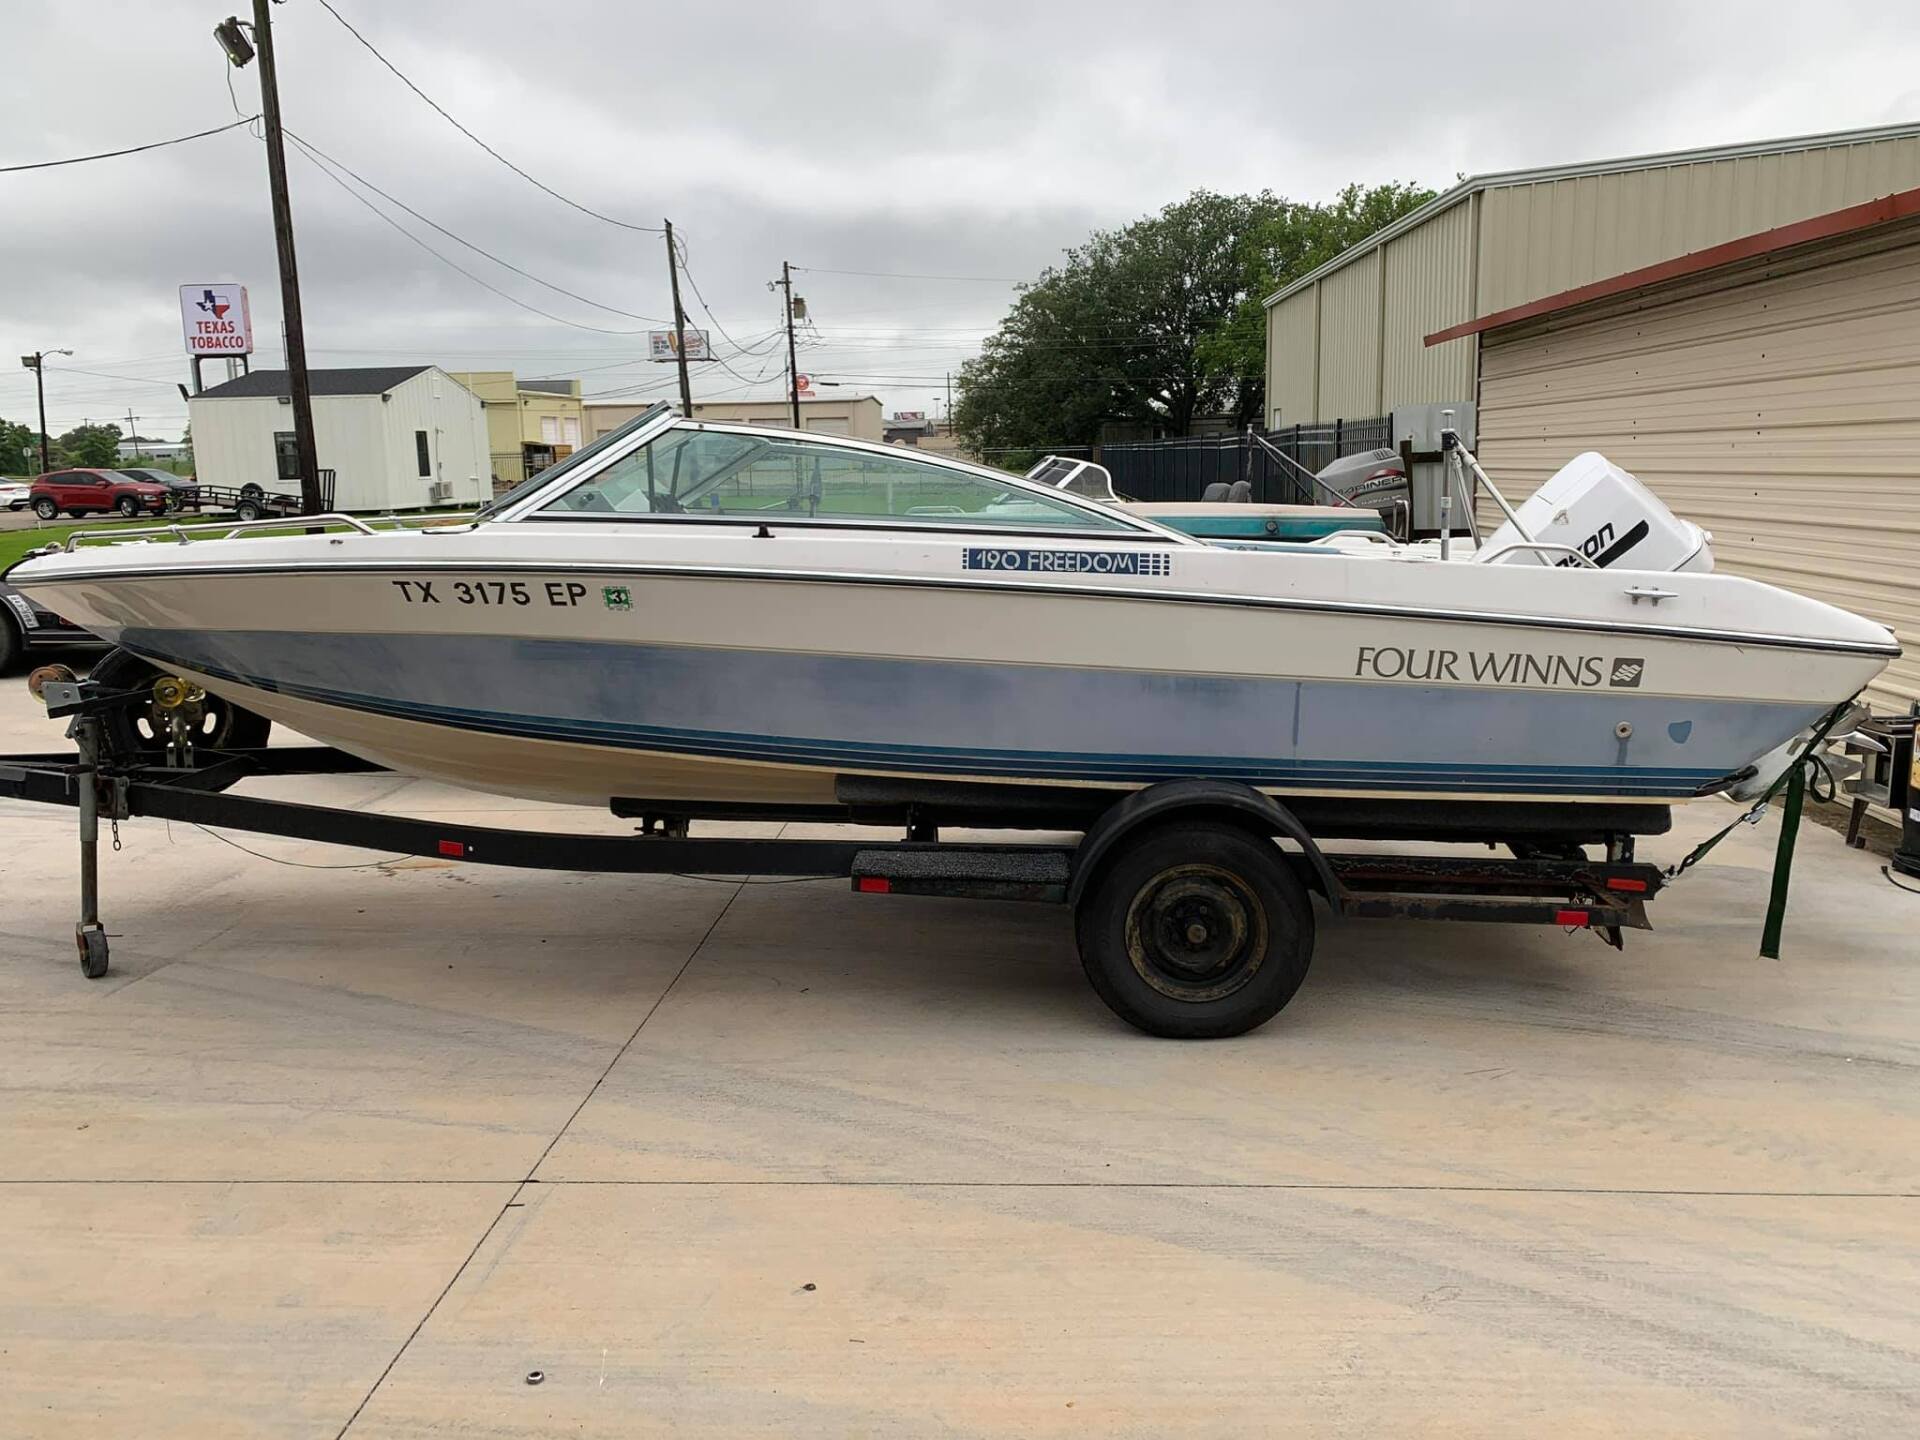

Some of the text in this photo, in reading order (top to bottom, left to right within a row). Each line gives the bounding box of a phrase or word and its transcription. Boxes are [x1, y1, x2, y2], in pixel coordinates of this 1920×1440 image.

[196, 321, 235, 334] TEXAS
[190, 336, 244, 349] TOBACCO
[976, 550, 1134, 573] 190 FREEDOM
[392, 580, 440, 603] TX
[453, 581, 531, 605] 3175
[544, 582, 587, 606] EP
[1355, 646, 1604, 687] FOUR WINNS
